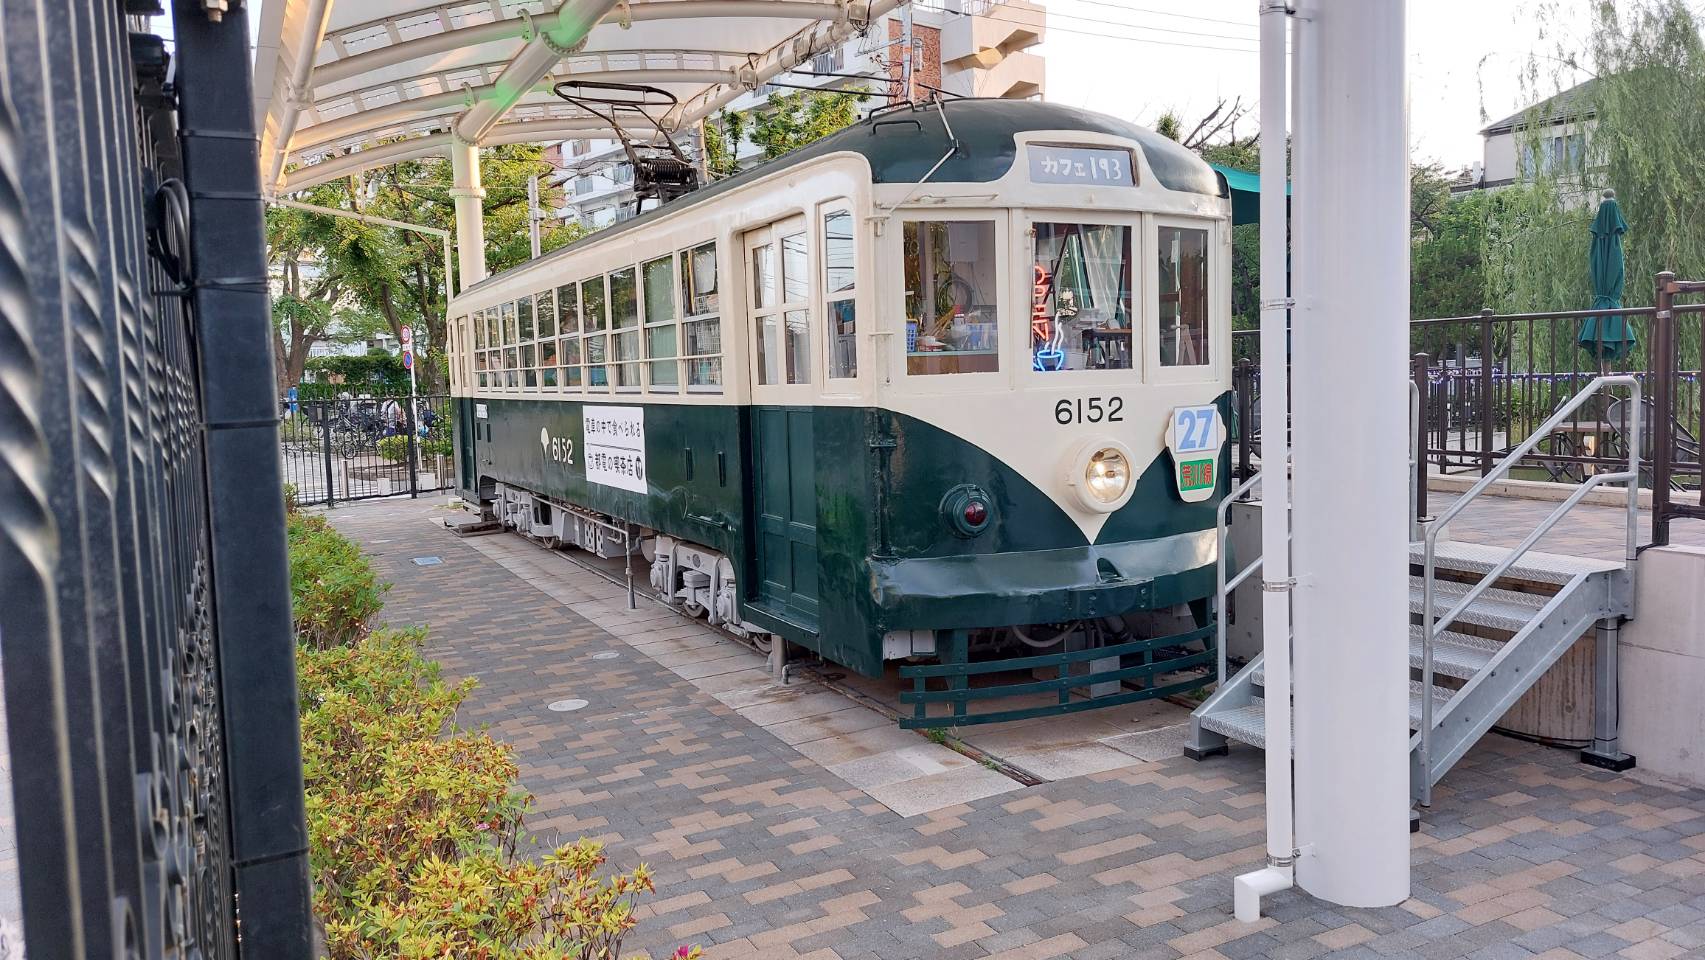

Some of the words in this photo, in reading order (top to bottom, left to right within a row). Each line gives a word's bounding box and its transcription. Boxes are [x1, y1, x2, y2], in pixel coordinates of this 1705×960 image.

[1055, 396, 1123, 425] 6152
[586, 417, 641, 437] 電車の中で食べられる
[1178, 409, 1214, 449] 27
[552, 437, 574, 465] 6152
